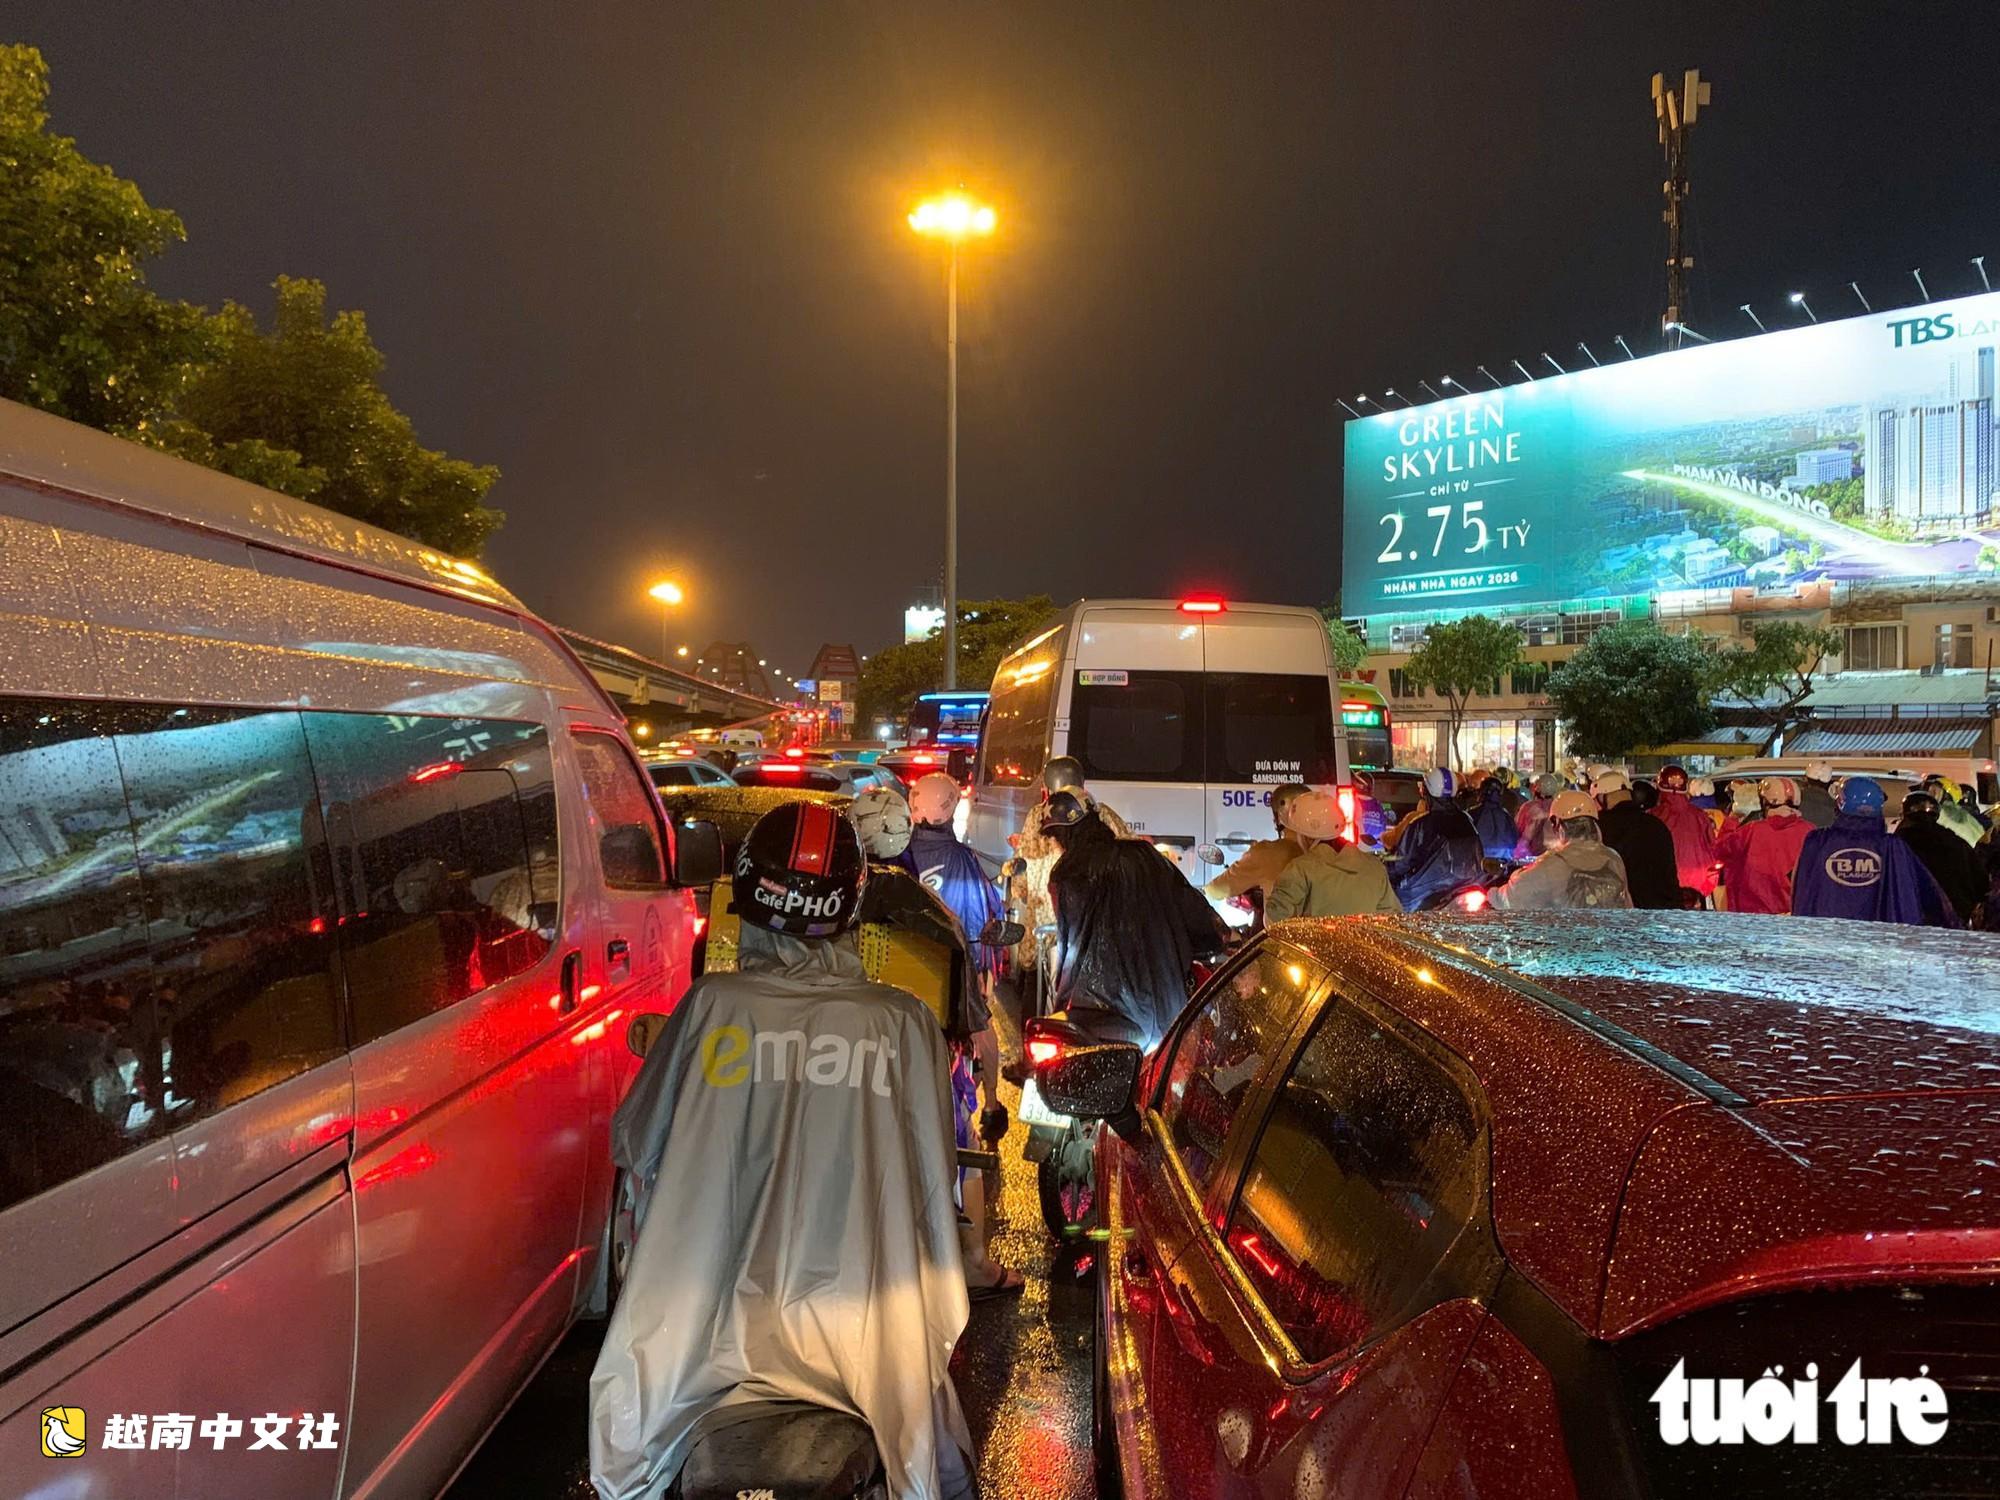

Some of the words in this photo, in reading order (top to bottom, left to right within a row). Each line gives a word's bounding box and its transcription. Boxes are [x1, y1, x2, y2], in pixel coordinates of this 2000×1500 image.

[1886, 313, 1955, 348] TBS
[1399, 400, 1504, 447] GREEN
[1384, 431, 1521, 482] SKYLINE
[1717, 466, 1758, 495] VĂN
[1377, 500, 1488, 563] 2.75
[1496, 518, 1531, 549] TỶ
[1384, 580, 1416, 594] NHẬN
[1421, 575, 1446, 589] NHÀ
[1451, 574, 1483, 588] NGAY
[1488, 571, 1518, 584] 2026
[1290, 761, 1301, 771] NV
[1222, 790, 1273, 808] 50E-0
[754, 886, 784, 910] Café
[783, 887, 844, 917] PHỐ
[702, 1024, 898, 1097] emart
